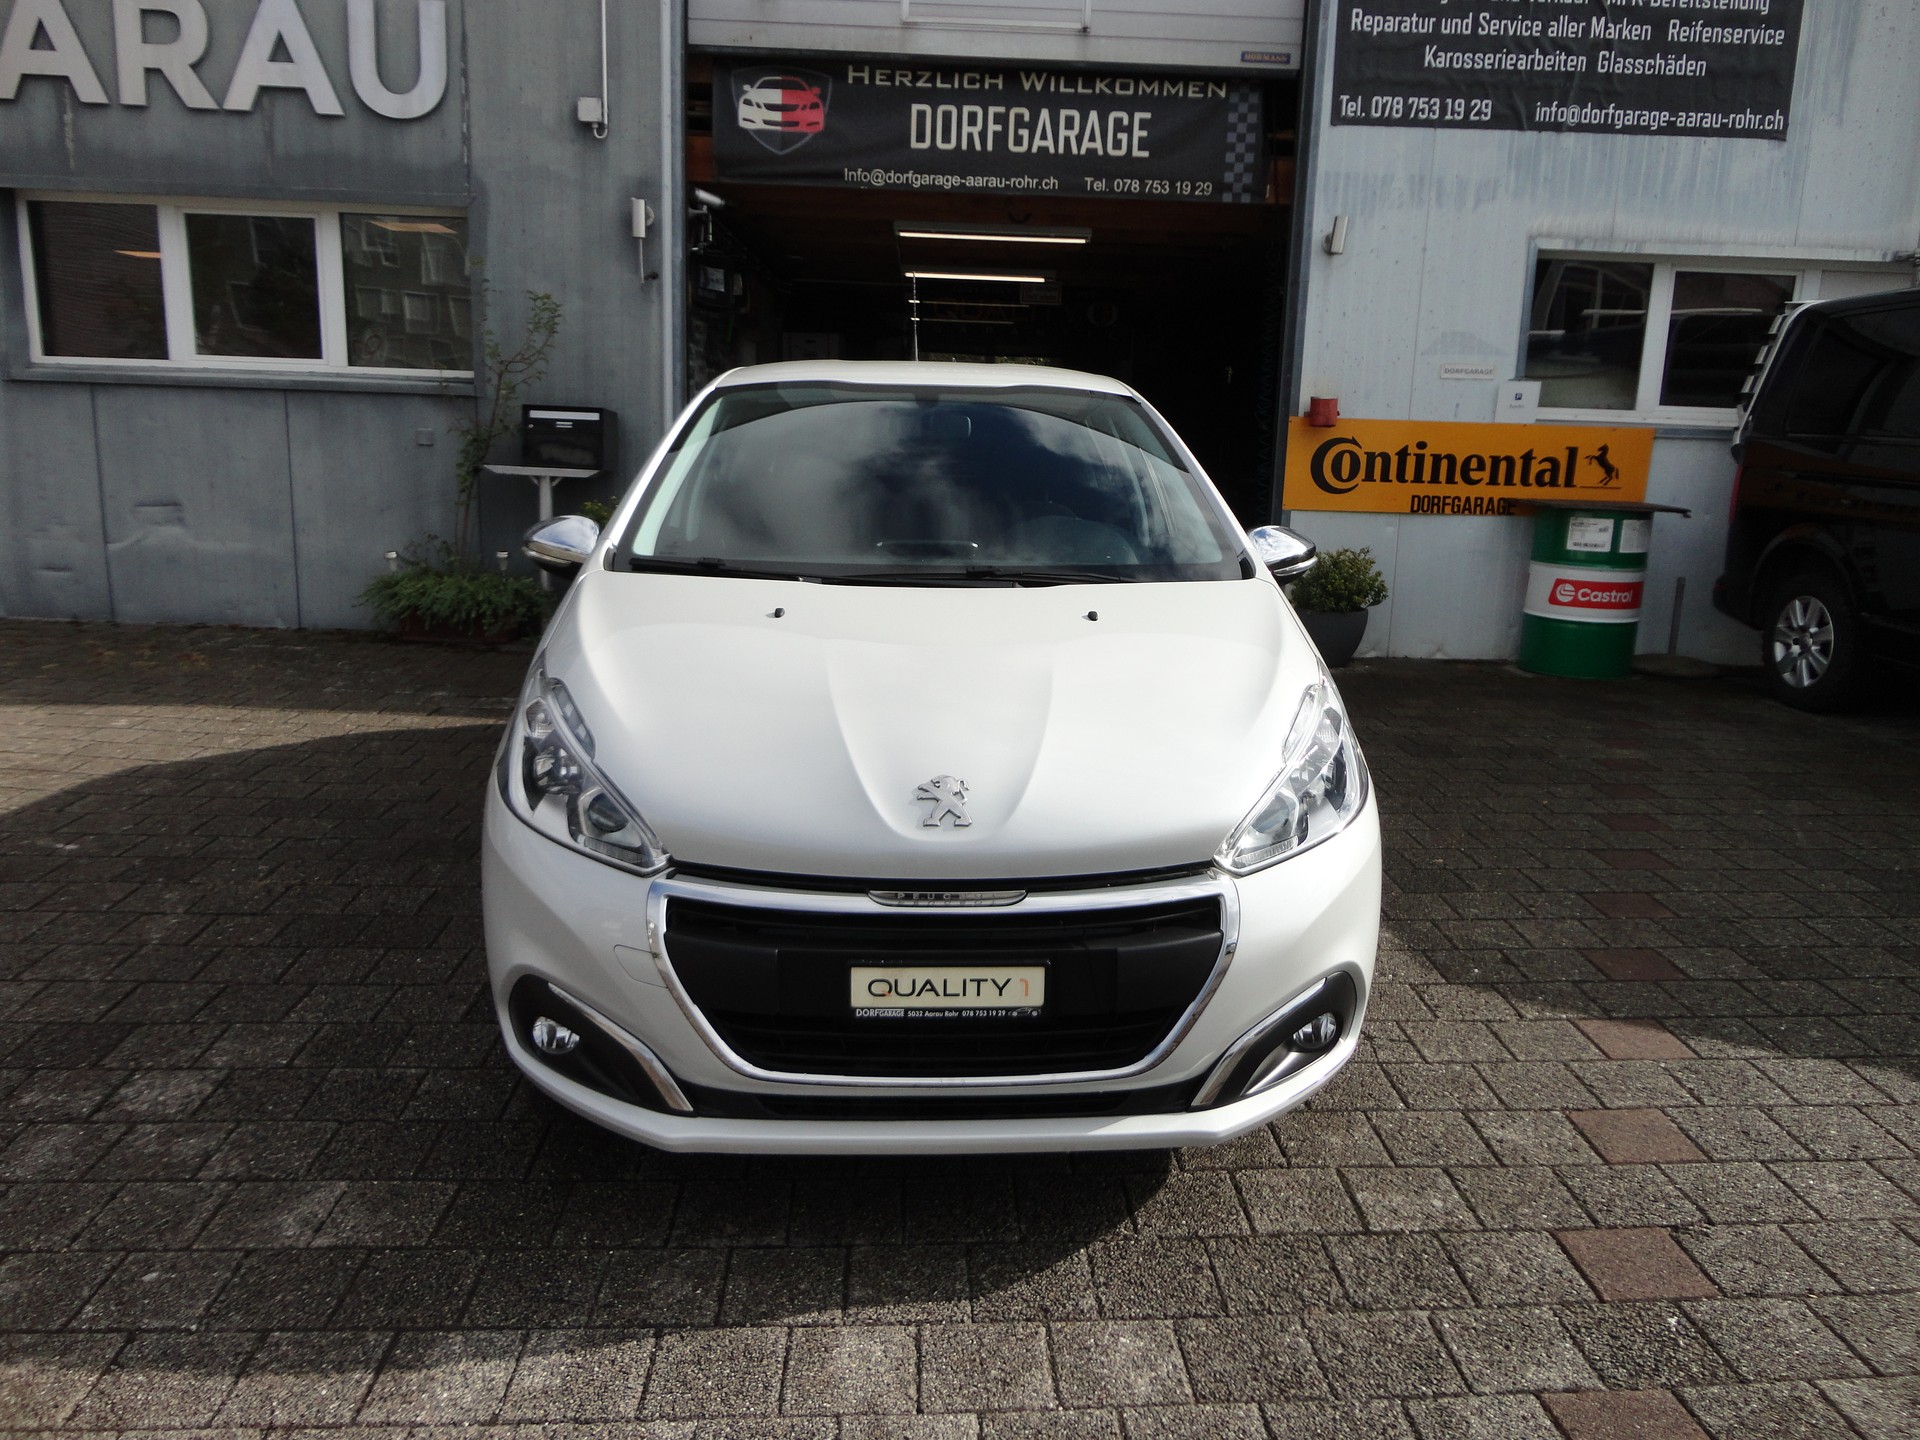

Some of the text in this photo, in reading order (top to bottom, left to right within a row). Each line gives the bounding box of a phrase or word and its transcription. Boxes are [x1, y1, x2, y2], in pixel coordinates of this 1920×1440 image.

[1351, 8, 1786, 45] Reparatur und Service aller Marken Reifenservice
[1424, 45, 1707, 77] Karosseriearbeiten Glasschäden
[847, 64, 1228, 99] HERZLICH WILLKOMMEN
[1340, 94, 1493, 122] Tel. 078 753 19 29
[1535, 101, 1784, 131] info@dorfgarage-aarau-rohr.ch
[910, 103, 1152, 158] DORFGARAGE
[844, 168, 1213, 196] Info@dorfgarage-aarau-rohr.ch Tel. 078 753 19 29
[1310, 436, 1579, 494] Continental
[1410, 495, 1516, 516] DORFGARAGE
[1577, 587, 1633, 603] Castrol
[868, 978, 1012, 997] QUALITY
[856, 1008, 904, 1017] DORFGARAGE
